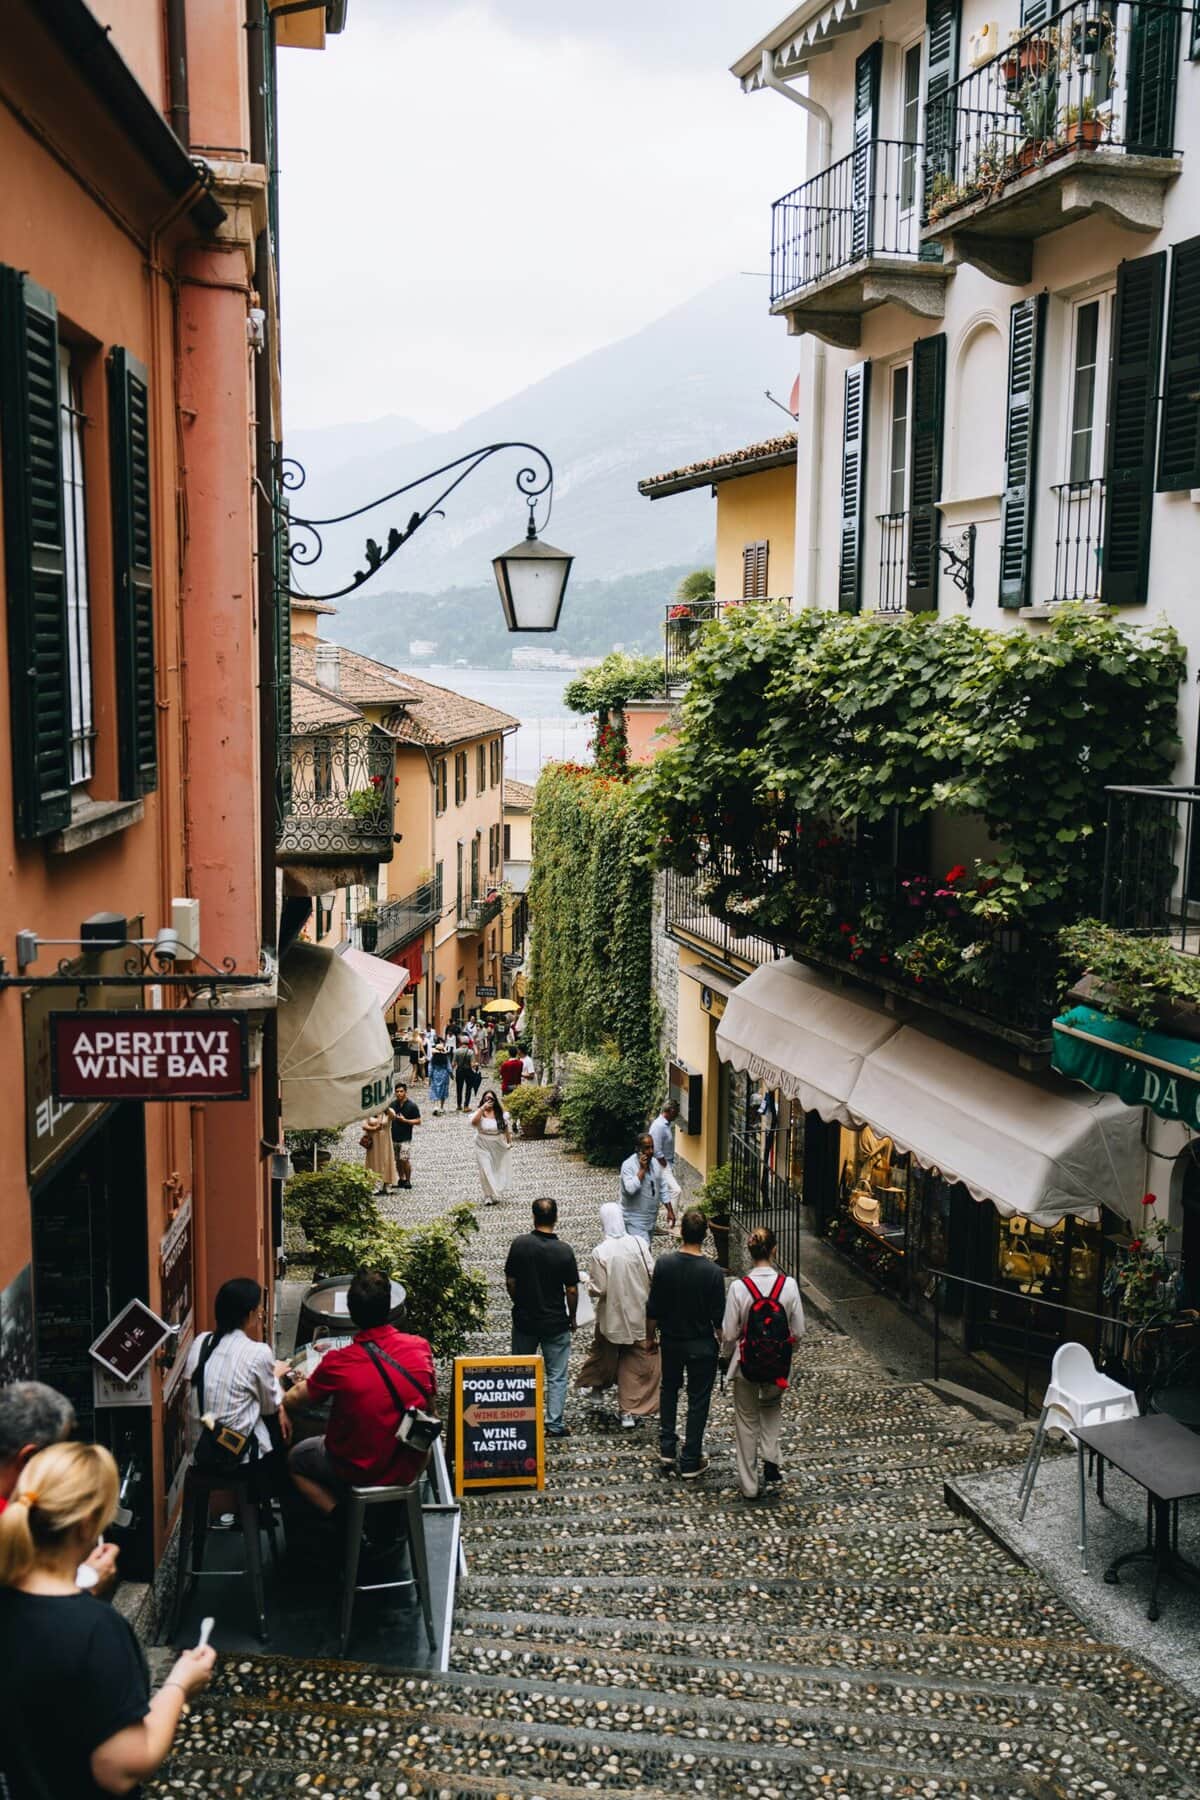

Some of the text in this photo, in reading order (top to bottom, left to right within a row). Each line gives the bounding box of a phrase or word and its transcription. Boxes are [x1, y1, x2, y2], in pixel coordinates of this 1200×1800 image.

[72, 1031, 230, 1056] APERITIVI
[76, 1054, 229, 1079] WINE BAR
[747, 1052, 801, 1097] Italian Style
[462, 1378, 537, 1391] FOOD & WINE
[474, 1391, 525, 1403] PAIRING
[473, 1407, 527, 1420] WINE SHOP
[482, 1427, 517, 1439] WINE
[472, 1439, 528, 1452] TASTING
